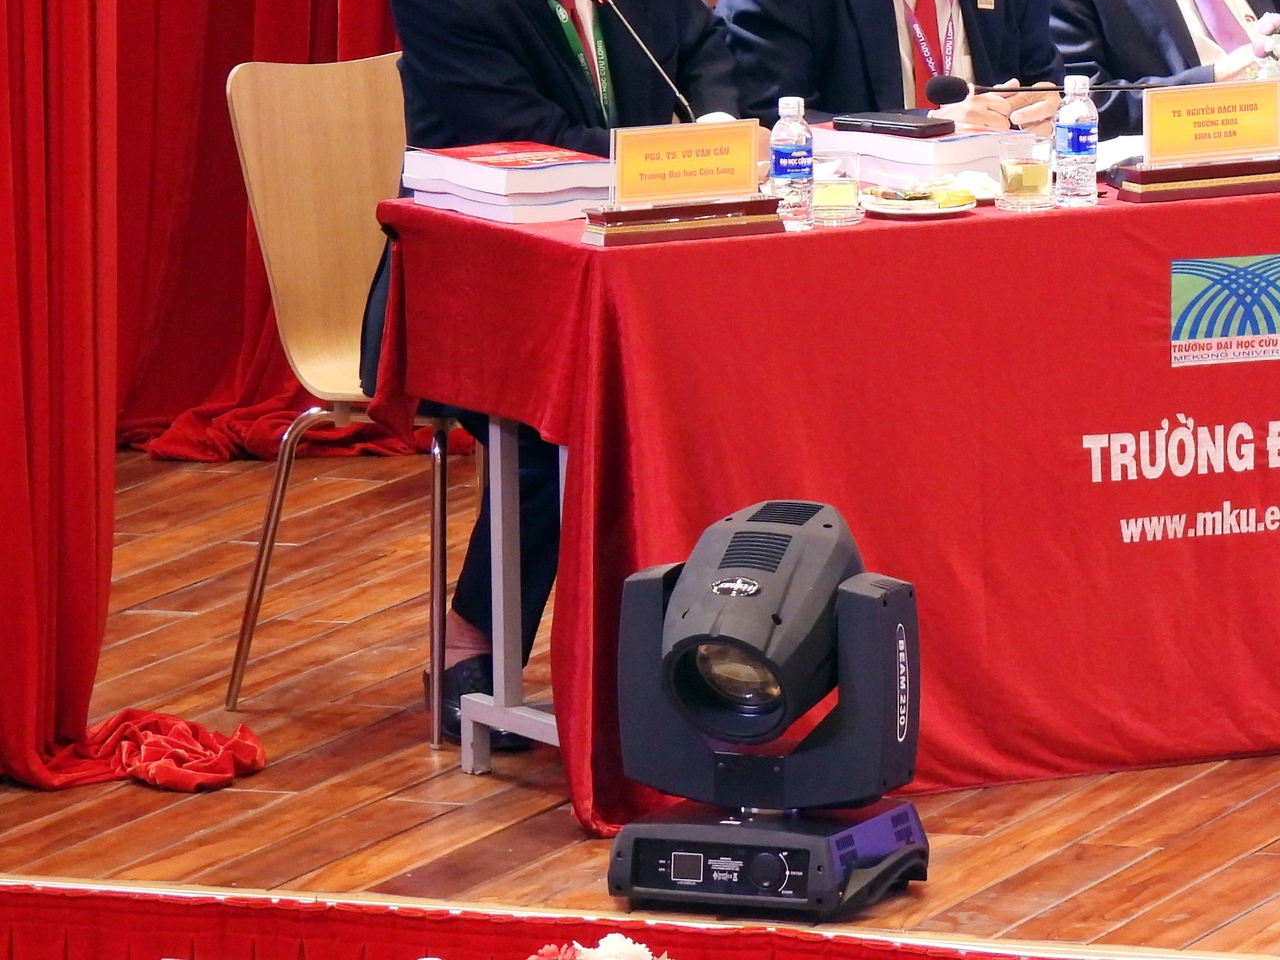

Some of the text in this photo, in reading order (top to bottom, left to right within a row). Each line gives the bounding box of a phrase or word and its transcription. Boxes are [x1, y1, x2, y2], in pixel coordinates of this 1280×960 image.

[913, 23, 924, 42] LONG
[1239, 103, 1259, 112] KHOA
[1221, 117, 1238, 126] KHOA
[1194, 132, 1212, 141] KHOA
[716, 167, 735, 176] Long
[1236, 339, 1256, 351] HỌC
[1173, 351, 1229, 362] MEKONG
[1082, 413, 1255, 483] TRƯỜNG
[898, 639, 906, 690] BEAM
